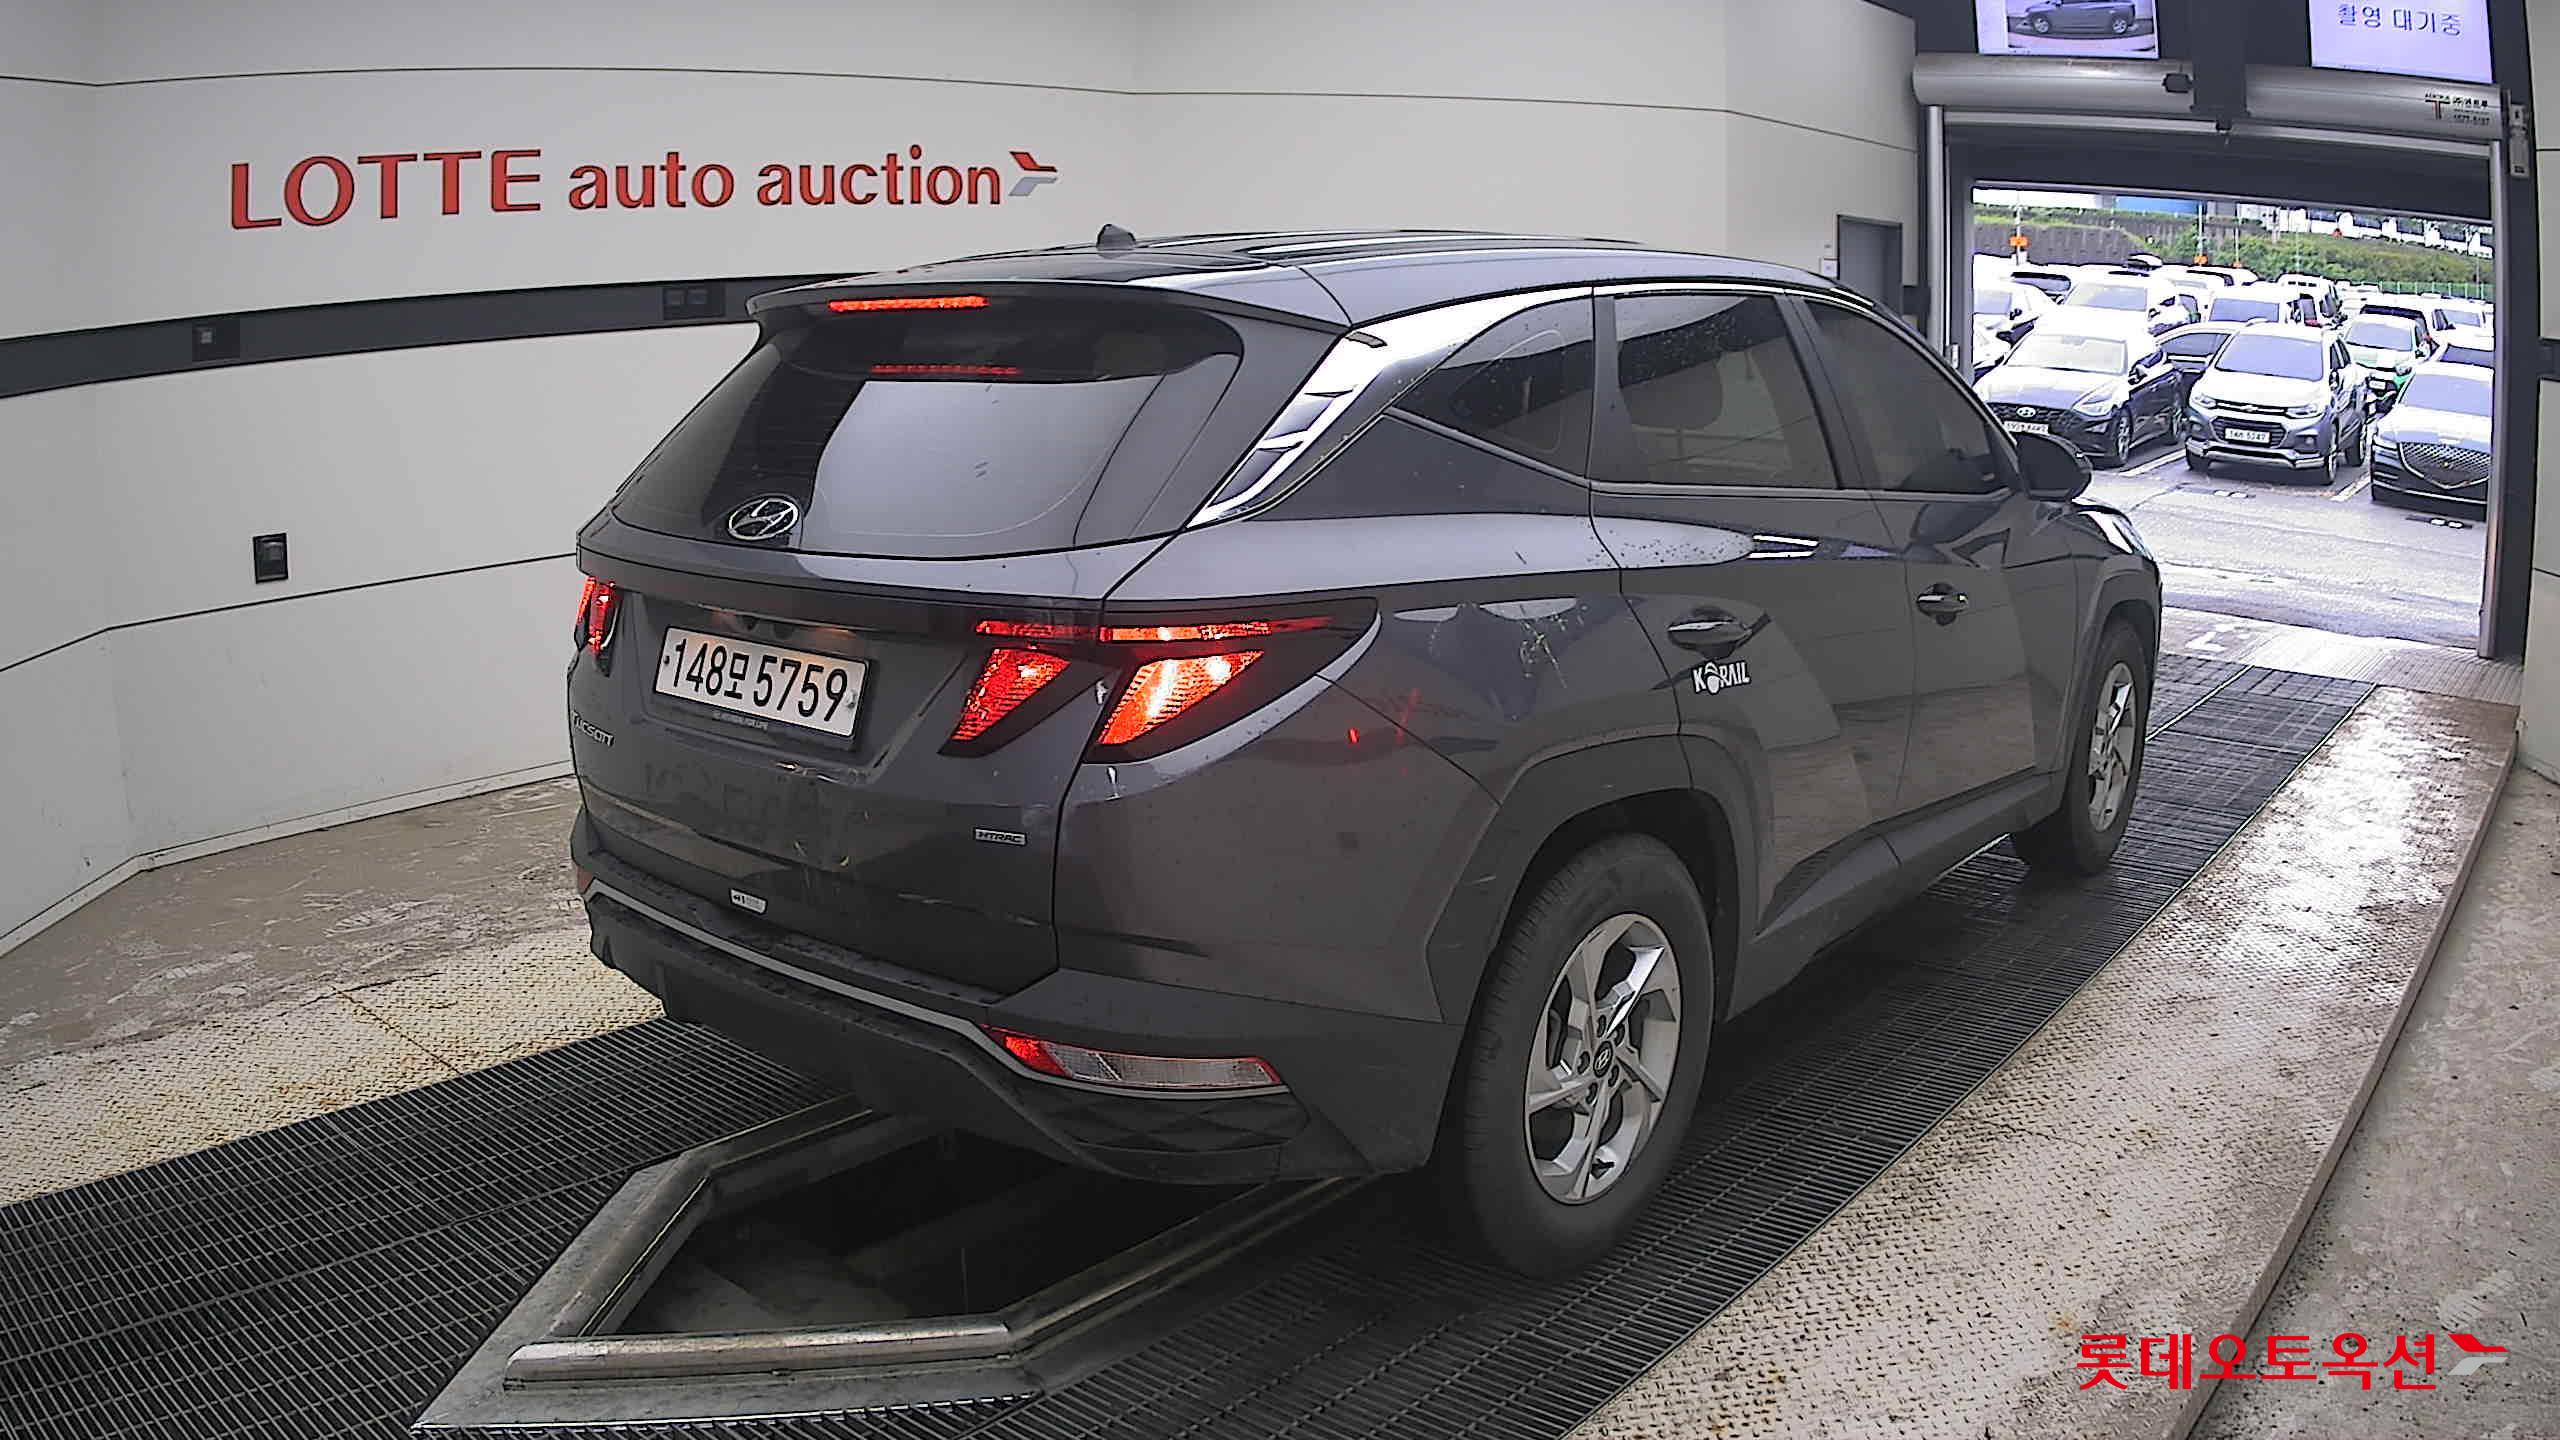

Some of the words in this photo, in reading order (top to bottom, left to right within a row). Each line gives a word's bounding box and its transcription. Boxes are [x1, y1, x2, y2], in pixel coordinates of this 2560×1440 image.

[2392, 8, 2461, 36] 대기중
[230, 148, 542, 230] LOTTE
[568, 150, 735, 210] auto
[756, 144, 1001, 206] auction
[753, 655, 848, 722] 5759
[1692, 660, 1751, 694] KORAIL
